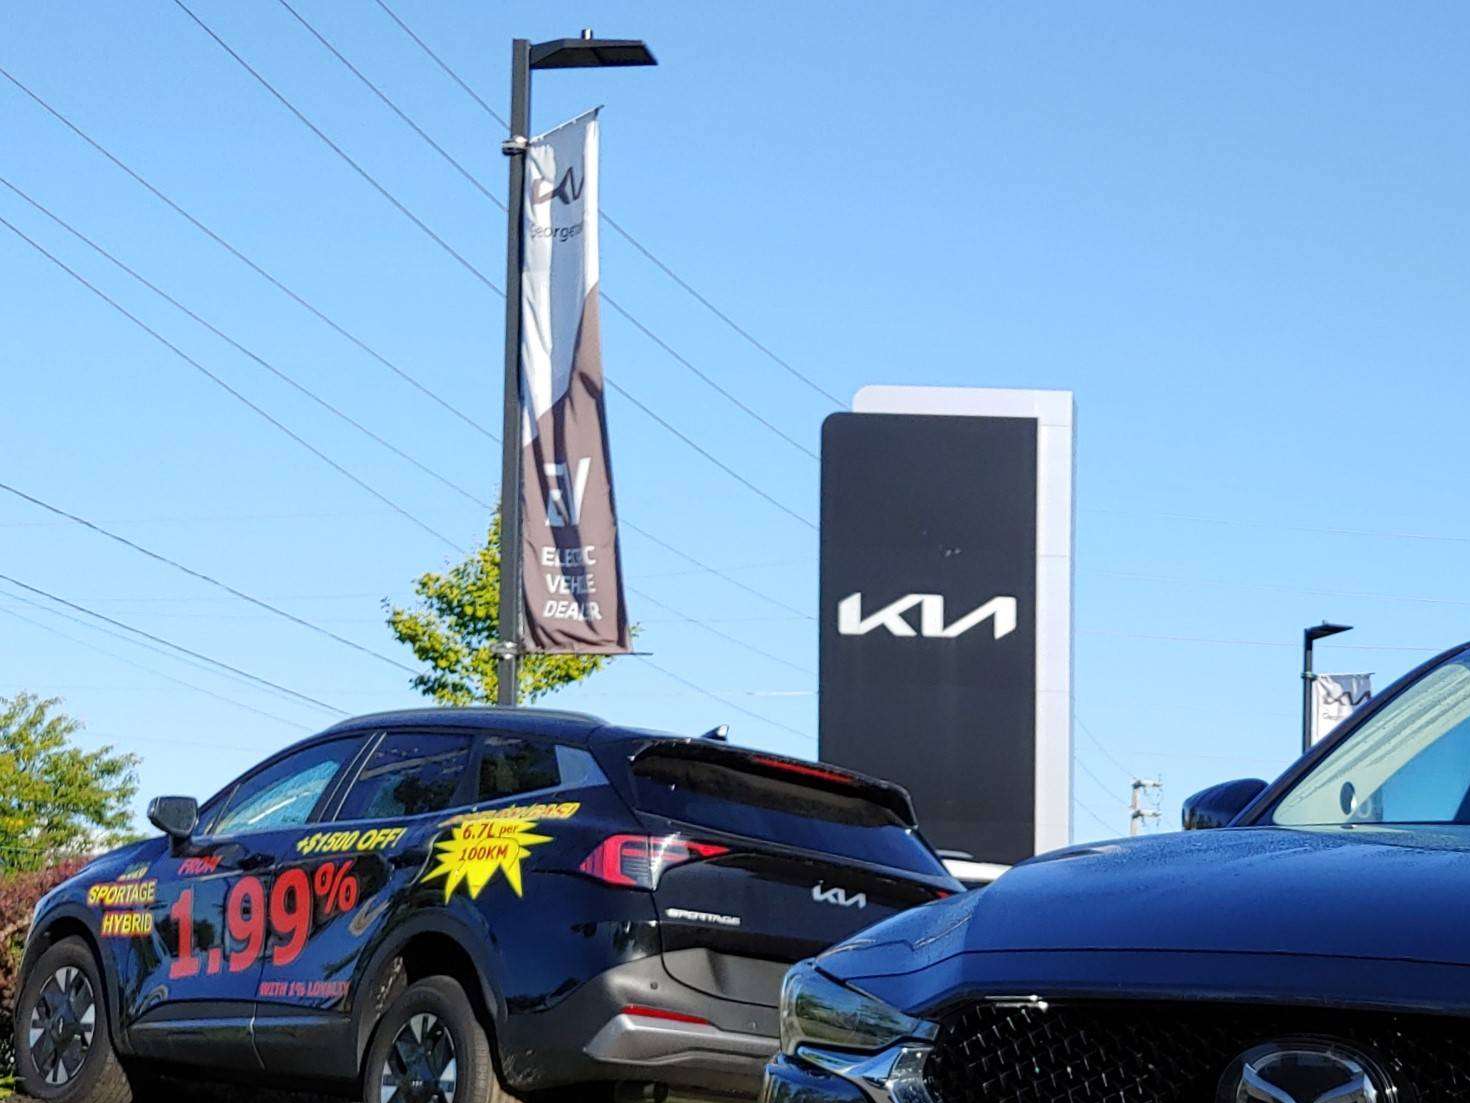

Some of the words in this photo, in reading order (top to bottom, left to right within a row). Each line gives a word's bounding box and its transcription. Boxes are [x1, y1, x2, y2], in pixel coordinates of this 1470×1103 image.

[838, 592, 1017, 640] KIA
[458, 845, 508, 862] 100KM
[87, 879, 157, 906] SPORTAGE
[812, 883, 867, 909] KIA
[102, 911, 153, 936] HYBRID
[168, 860, 358, 980] 1.99%
